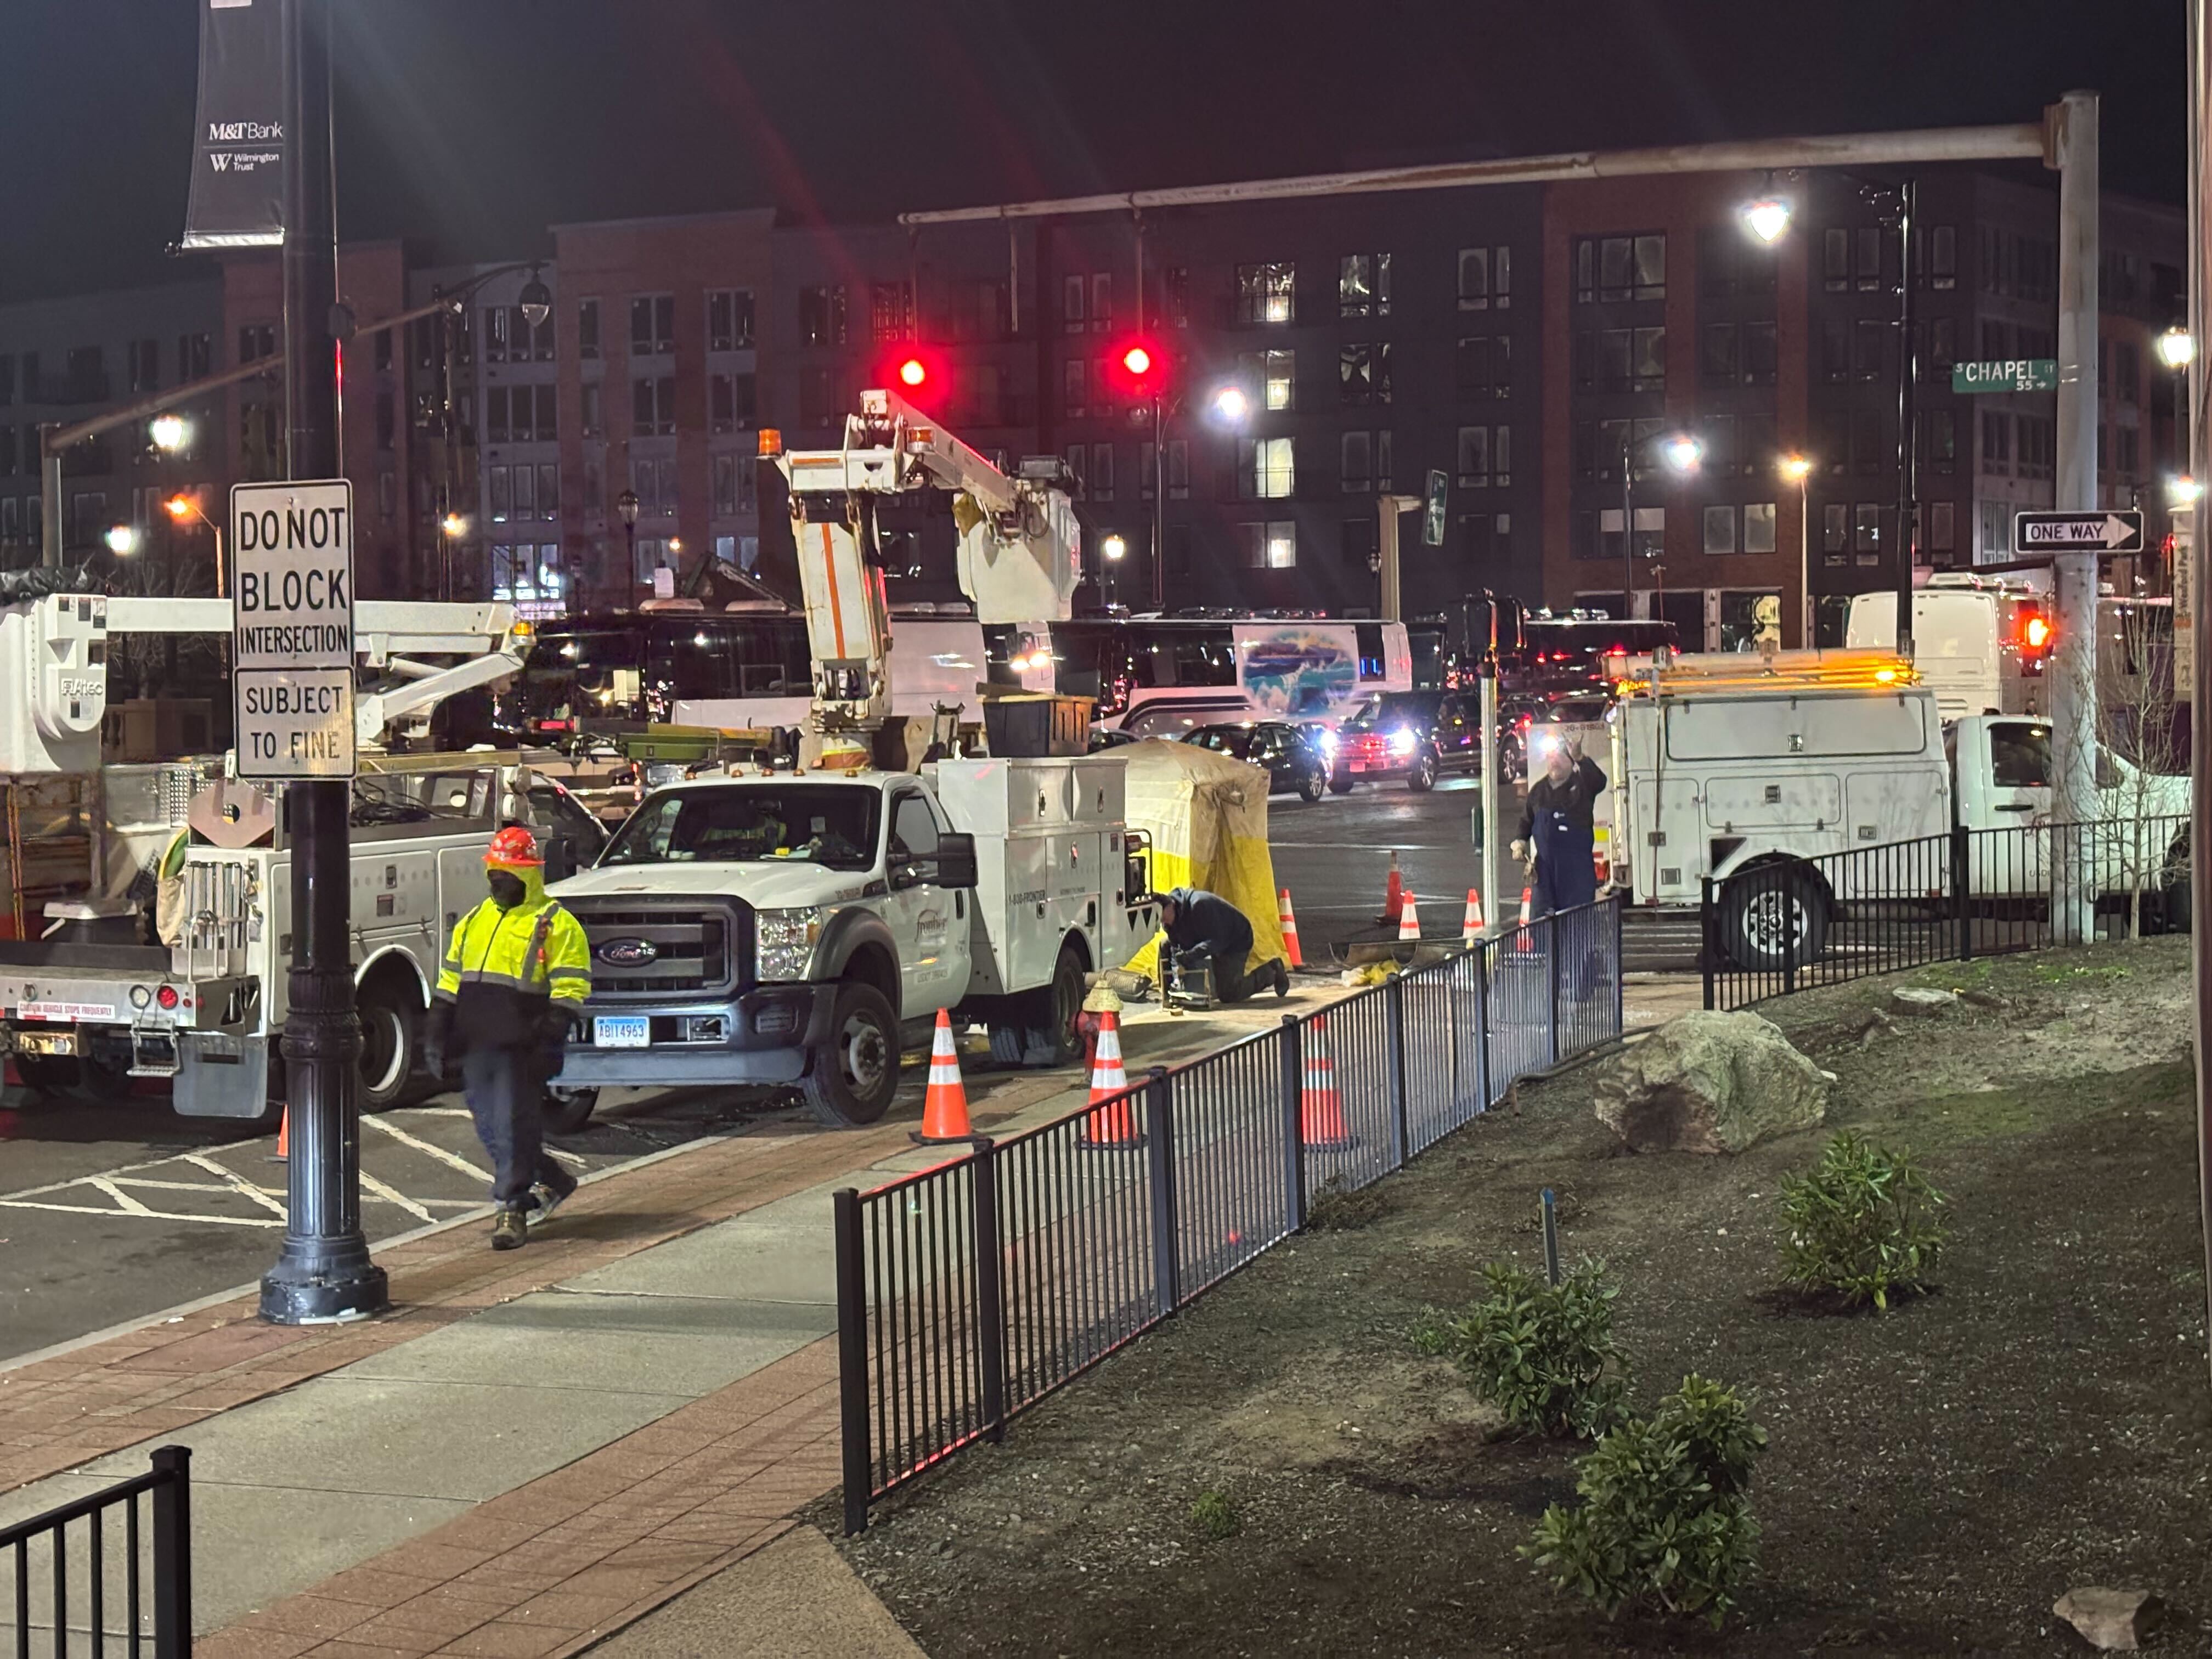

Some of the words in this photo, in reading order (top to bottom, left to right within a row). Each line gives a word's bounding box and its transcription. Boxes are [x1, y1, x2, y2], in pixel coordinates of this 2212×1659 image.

[209, 122, 247, 140] M&T
[248, 121, 282, 139] Bank
[234, 153, 279, 163] Wilmington
[234, 162, 254, 171] Trust
[1955, 363, 1963, 373] S
[1966, 360, 2038, 382] CHAPEL
[2016, 380, 2033, 391] 55
[240, 510, 279, 551] DO
[287, 507, 345, 549] NOT
[2031, 525, 2063, 540] ONE
[2070, 524, 2103, 539] WAY
[241, 569, 347, 611] BLOCK
[240, 625, 348, 653] INTERSECTION
[246, 686, 343, 714] SUBJECT
[251, 732, 276, 758] TO
[291, 731, 340, 758] FINE
[43, 1004, 63, 1013] VEHICLE
[64, 1005, 80, 1014] STOPS
